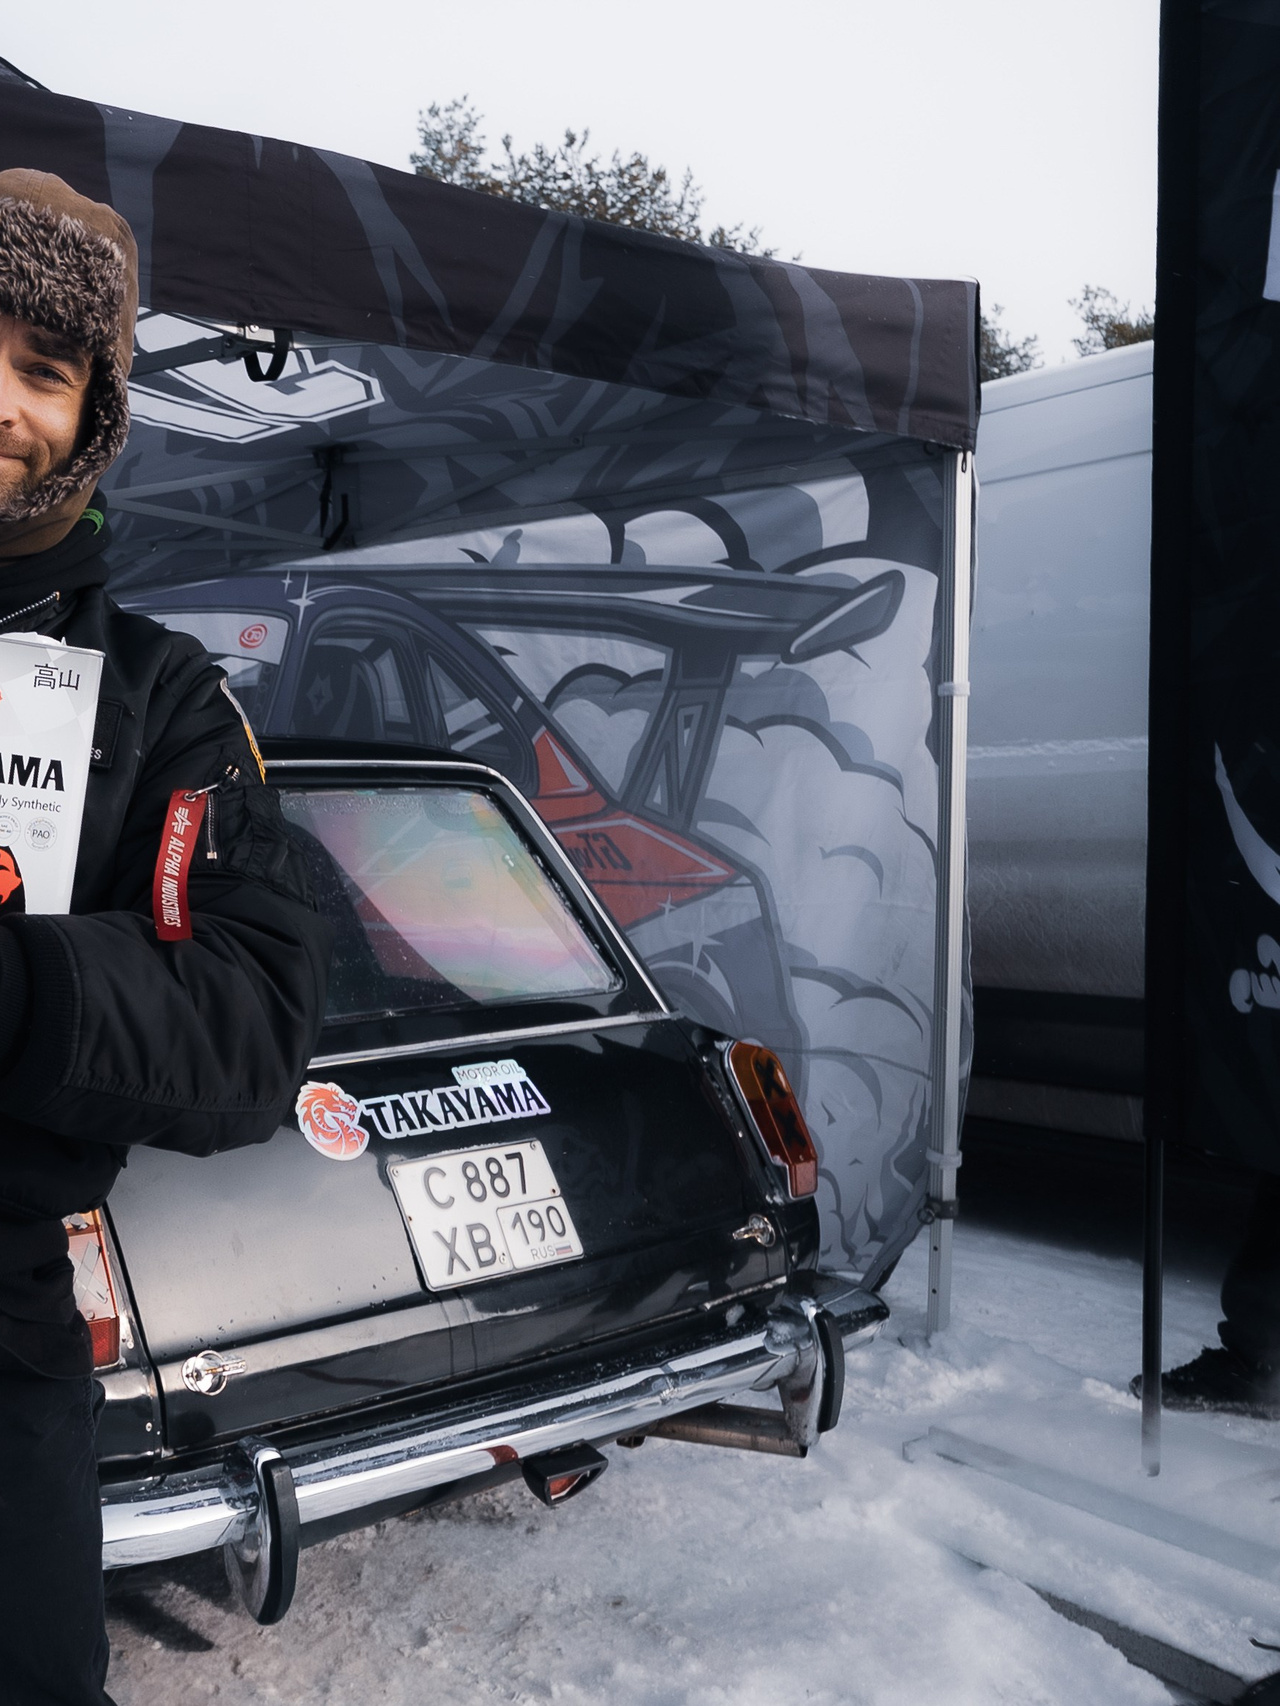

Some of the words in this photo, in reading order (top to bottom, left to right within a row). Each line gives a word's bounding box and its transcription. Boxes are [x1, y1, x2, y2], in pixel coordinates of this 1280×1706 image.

[33, 663, 81, 691] 高山
[11, 796, 62, 813] Synthetic
[32, 829, 51, 840] PAO
[163, 835, 186, 877] ALPHA
[161, 876, 182, 928] INDUSTRIES
[456, 1065, 499, 1082] MOTOR
[500, 1063, 522, 1077] OIL
[367, 1081, 547, 1135] TAKAYAMA
[461, 1151, 528, 1203] 887
[511, 1205, 567, 1246] 190
[530, 1245, 556, 1261] RUS
